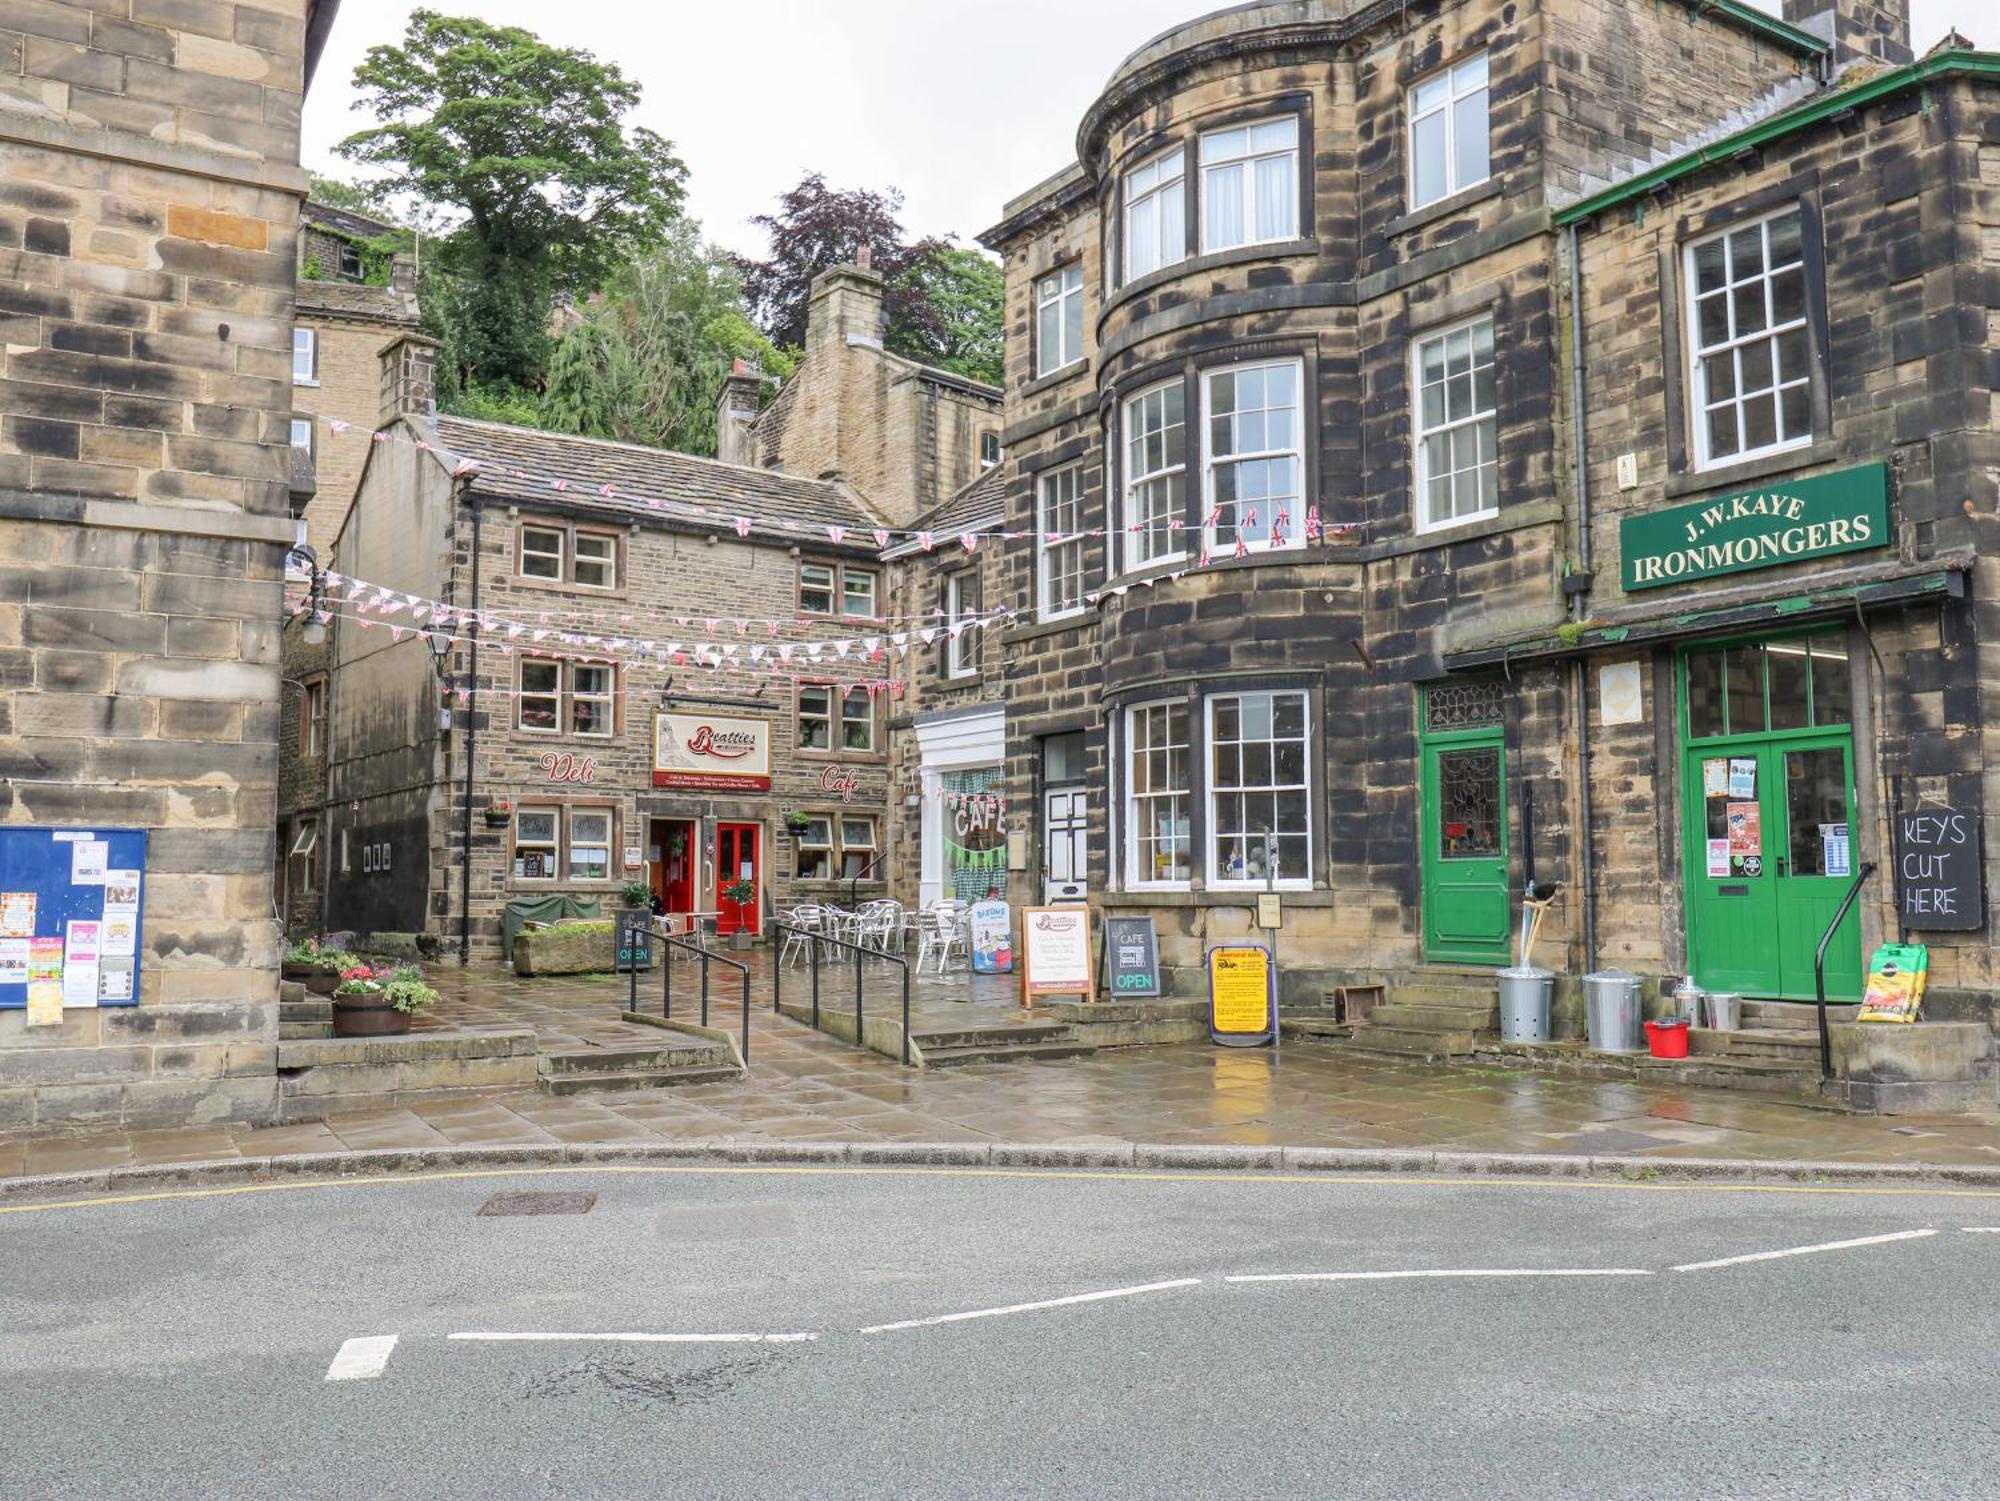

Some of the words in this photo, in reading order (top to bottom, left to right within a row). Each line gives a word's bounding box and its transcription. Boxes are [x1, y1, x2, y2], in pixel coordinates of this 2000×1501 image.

[1633, 514, 1871, 582] IRONMONGERS
[687, 723, 757, 757] Beatties
[540, 752, 598, 784] Deli
[821, 765, 860, 803] Cafe
[1904, 815, 1966, 845] KEYS
[1903, 852, 1951, 880] CUT
[1906, 887, 1958, 915] HERE
[1120, 933, 1146, 945] CAFE
[1116, 973, 1153, 989] OPEN
